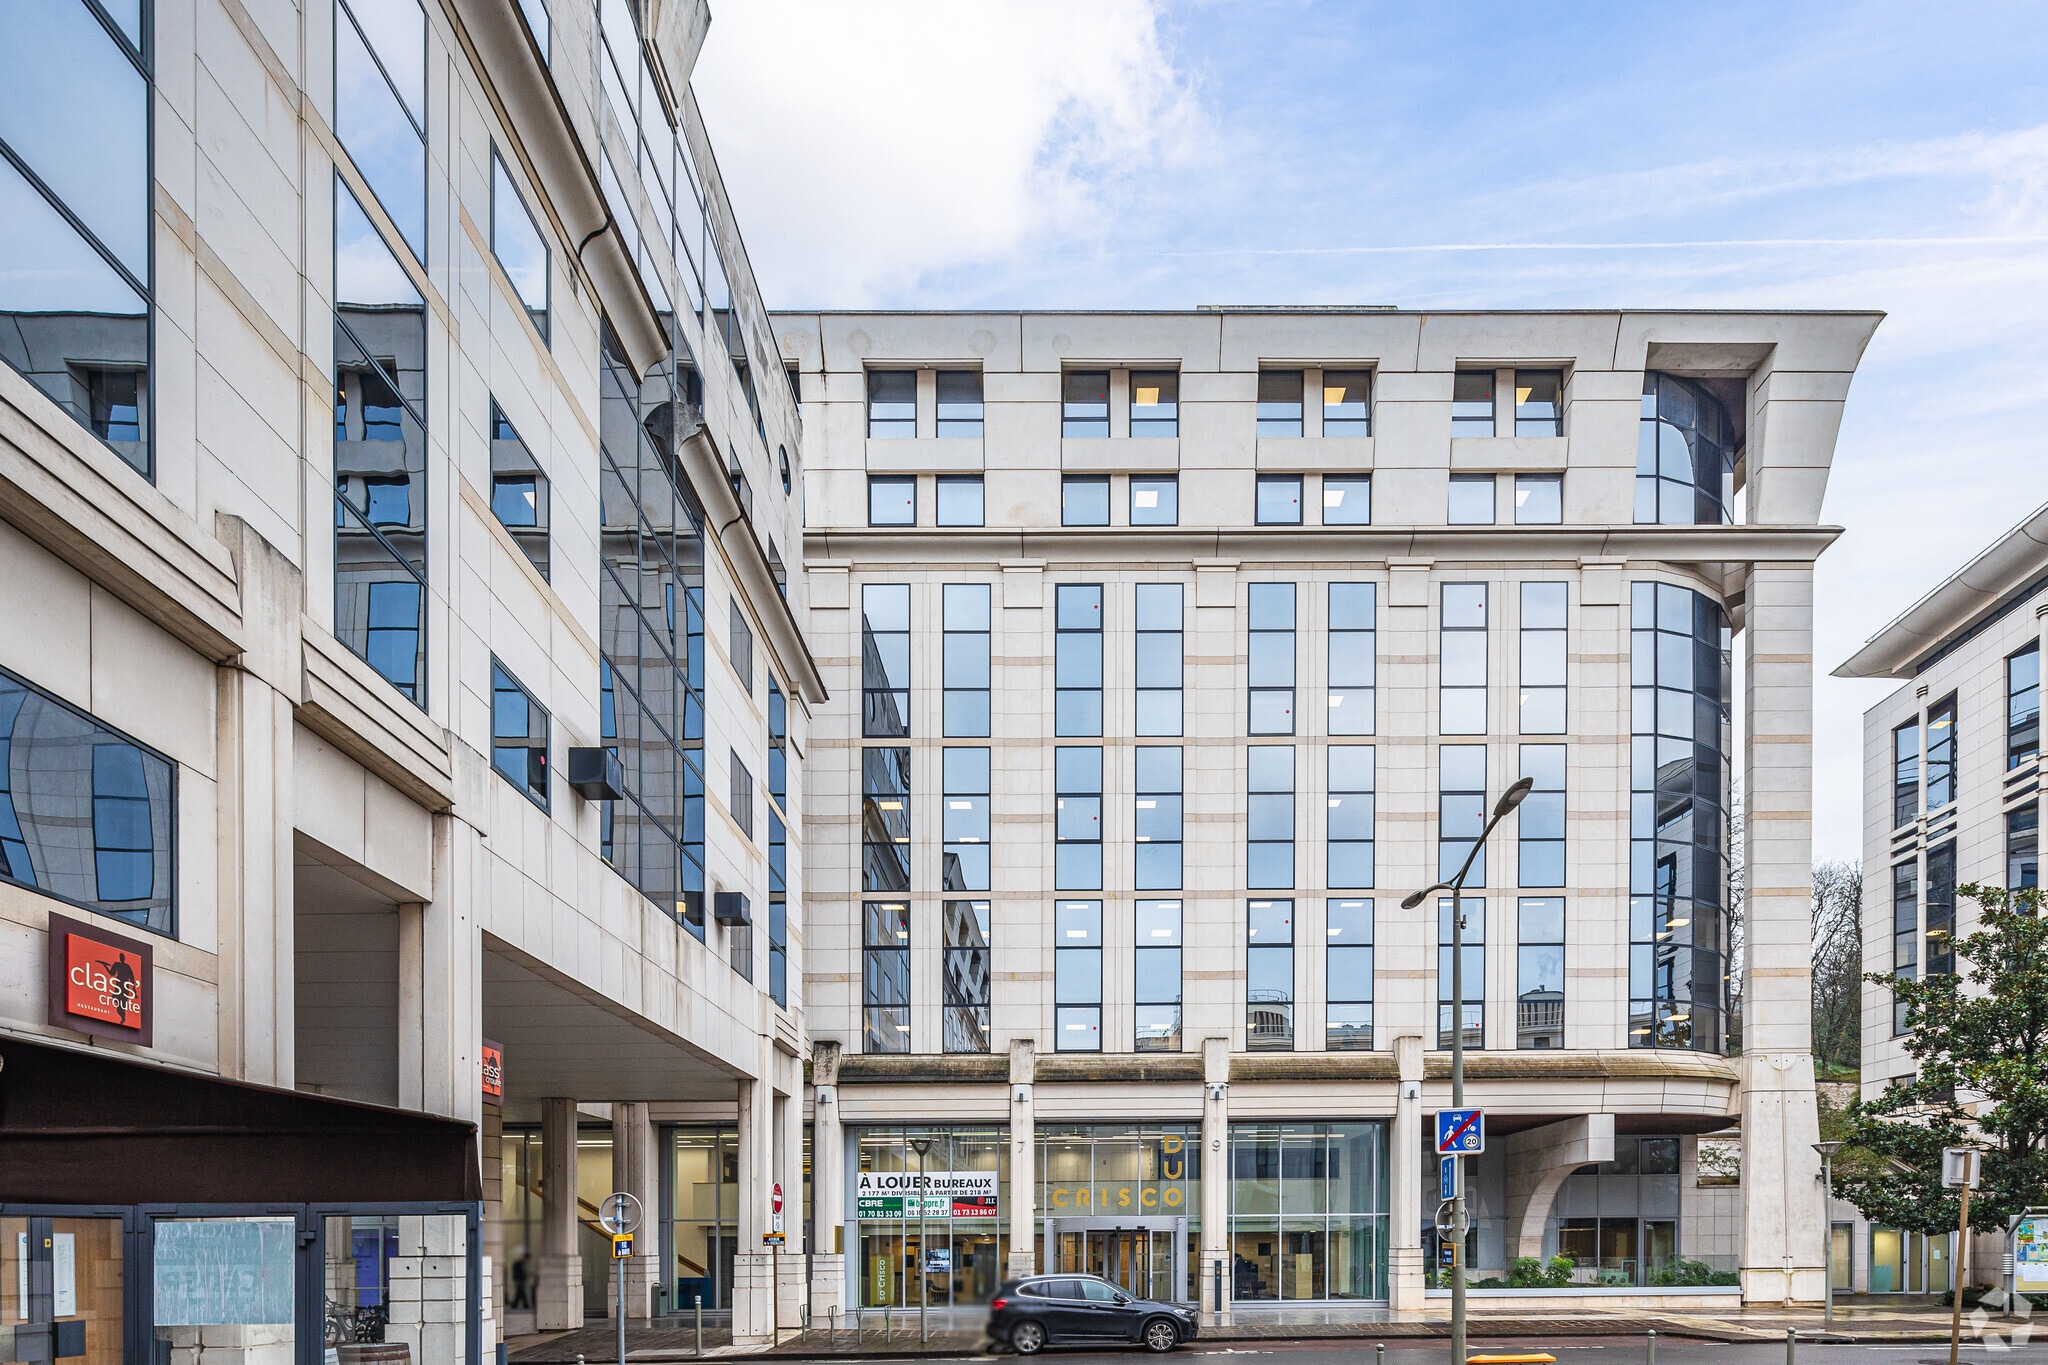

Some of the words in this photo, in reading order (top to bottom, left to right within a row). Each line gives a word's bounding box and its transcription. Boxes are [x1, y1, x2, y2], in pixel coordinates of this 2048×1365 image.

[70, 962, 140, 999] class'
[77, 1002, 111, 1014] RESTAURANT
[99, 994, 140, 1013] croute
[482, 1064, 501, 1078] ass'
[1017, 1141, 1026, 1153] 7
[1212, 1139, 1220, 1152] 9
[860, 1173, 871, 1188] À
[878, 1177, 931, 1188] LOUER
[934, 1179, 992, 1188] BUREAUX
[916, 1199, 945, 1209] bppre.fr
[1052, 1187, 1182, 1207] CRISCO
